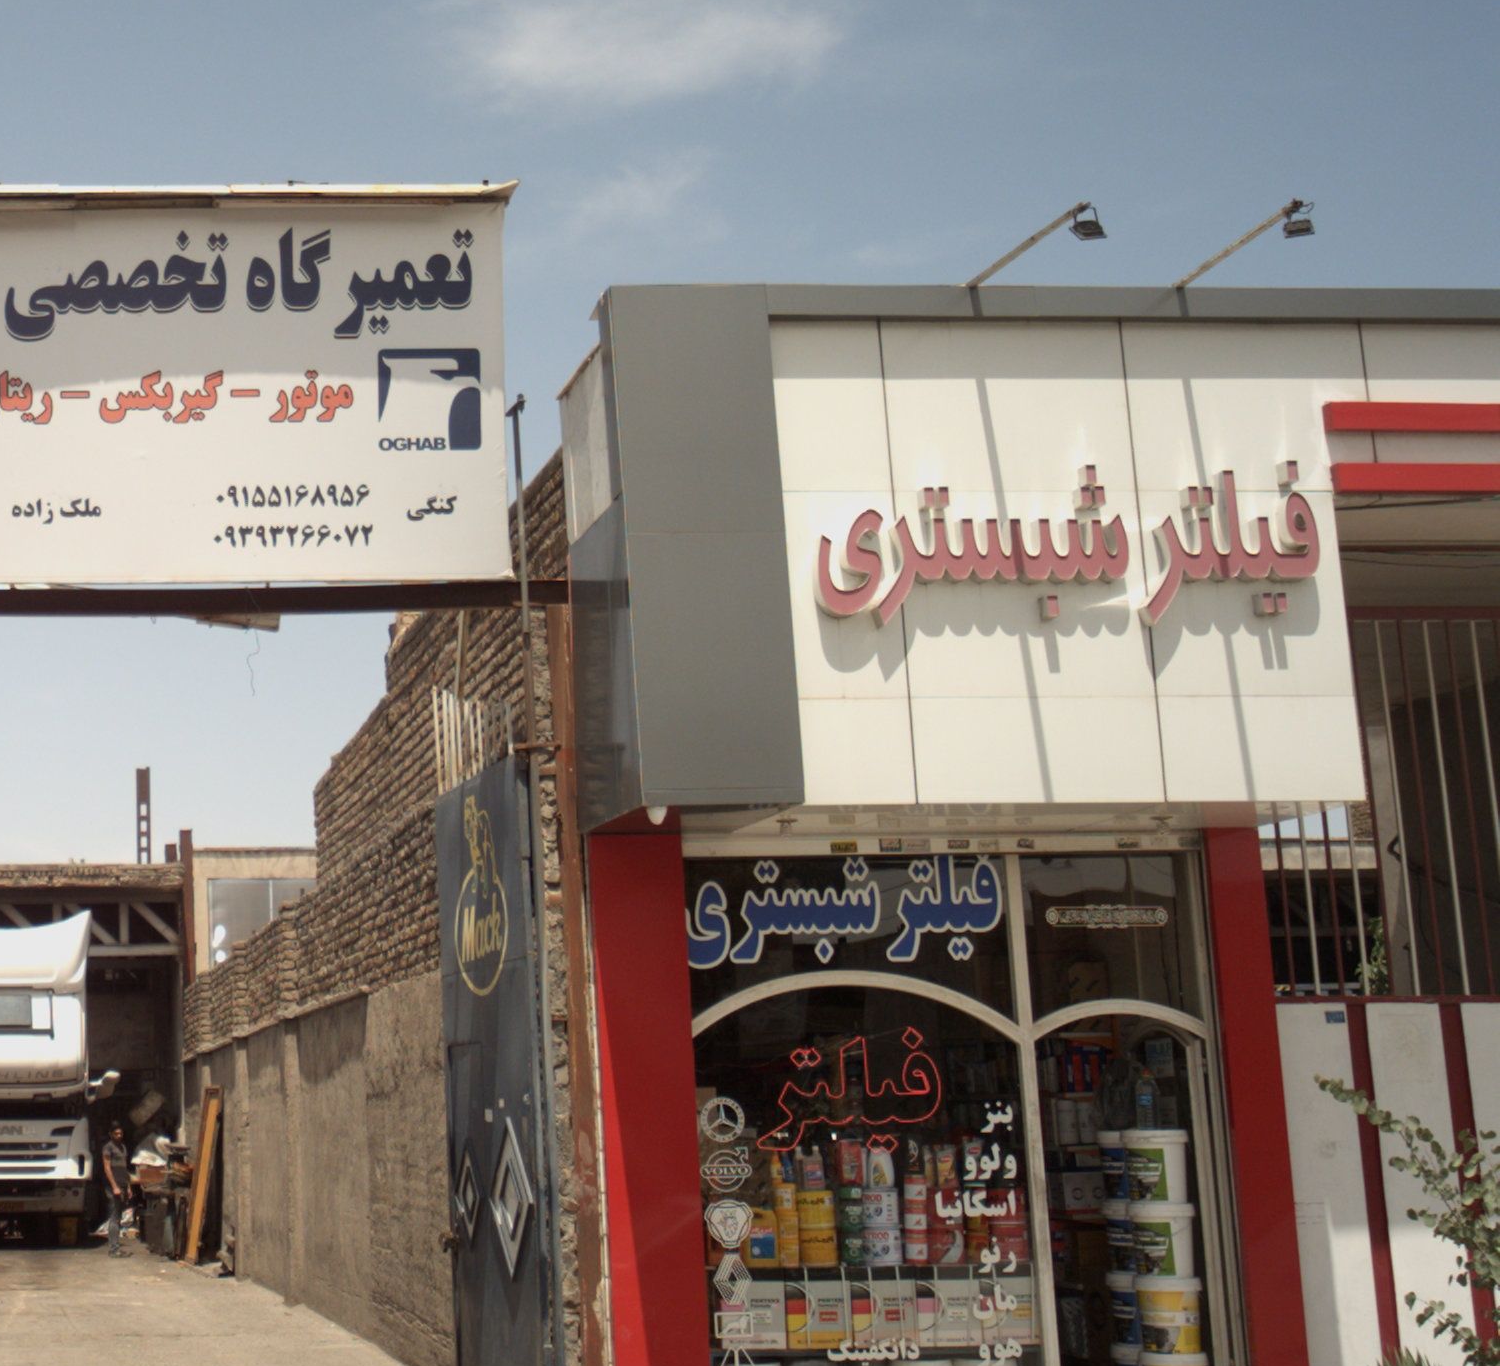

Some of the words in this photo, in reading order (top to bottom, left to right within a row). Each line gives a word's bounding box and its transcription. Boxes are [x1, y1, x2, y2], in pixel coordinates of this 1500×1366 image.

[4, 230, 228, 341] تخصصی
[99, 370, 224, 424] گیربکس
[269, 369, 354, 423] موتور
[378, 437, 447, 451] OGHAB
[216, 483, 371, 507] ۰۹۱۵۵۱۶۸۹۵۶
[213, 523, 374, 548] ۰۹۳۹۳۲۶۶۰۷۲
[814, 464, 1131, 629] شبستری
[1138, 460, 1321, 627] فیلتر
[462, 891, 502, 964] Mack
[684, 855, 881, 970] شبستری
[886, 855, 1003, 962] فیلتر
[756, 1025, 942, 1152] فیلتر
[980, 1100, 1014, 1134] بنز
[703, 1167, 749, 1175] VOLVO
[963, 1142, 1018, 1181] ولوو
[934, 1189, 1017, 1225] اسکانیا
[978, 1236, 1018, 1274] رنو
[973, 1283, 1018, 1321] مان
